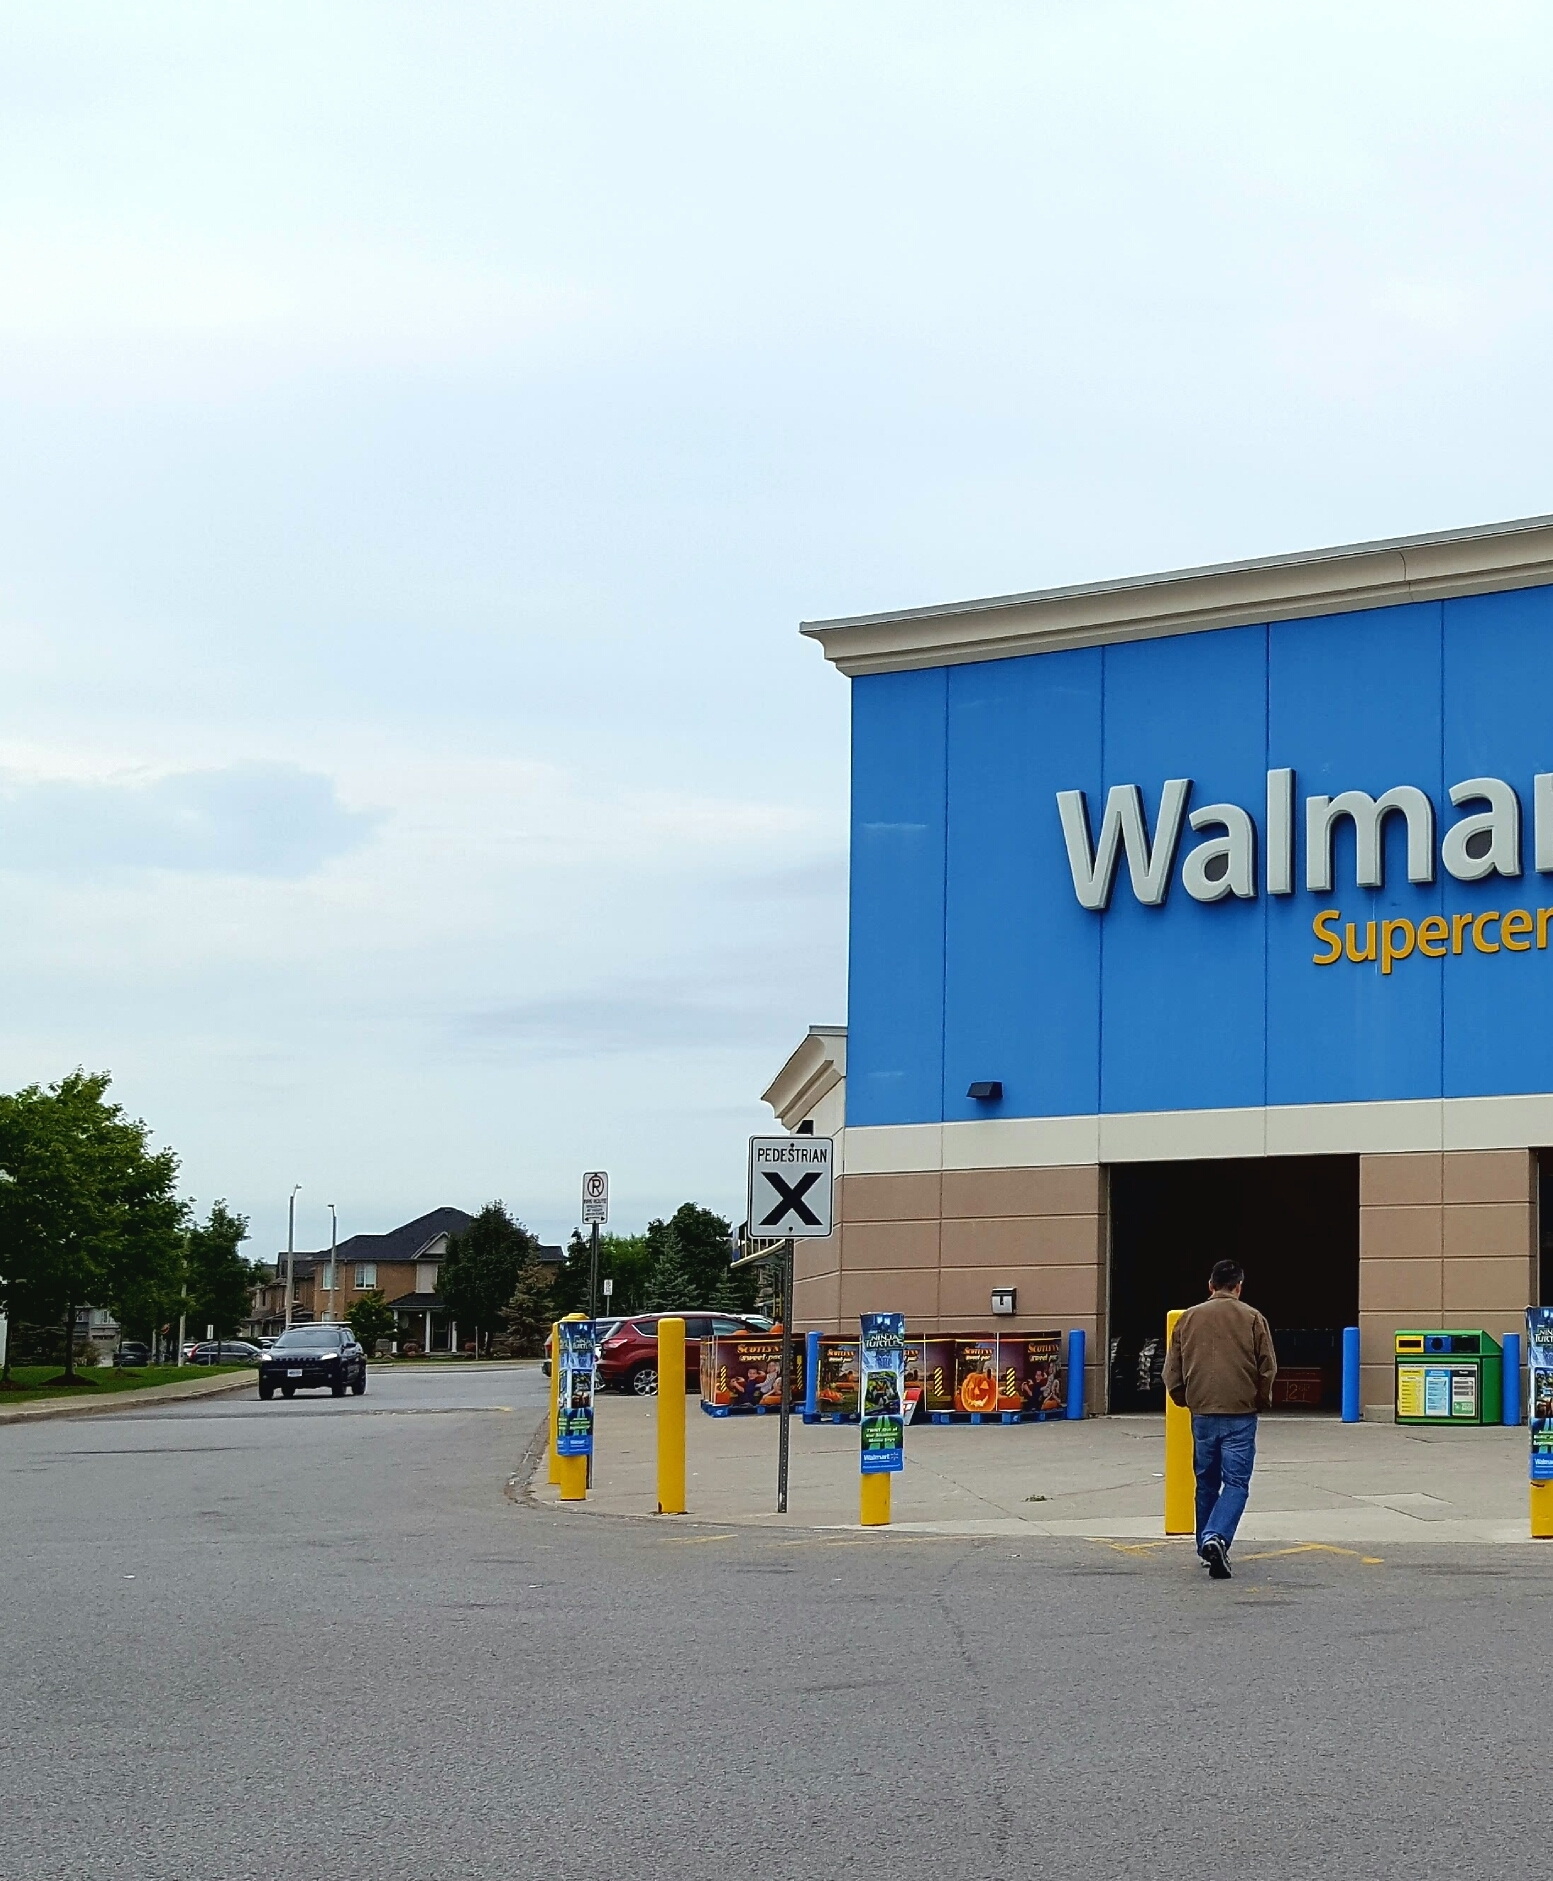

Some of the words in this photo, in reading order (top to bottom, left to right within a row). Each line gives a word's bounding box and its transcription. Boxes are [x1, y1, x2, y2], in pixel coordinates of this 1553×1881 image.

[757, 1147, 828, 1163] PEDESTRIAN
[871, 1333, 898, 1341] NINJA
[865, 1339, 905, 1348] TURTLES
[863, 1453, 891, 1461] Walmart
